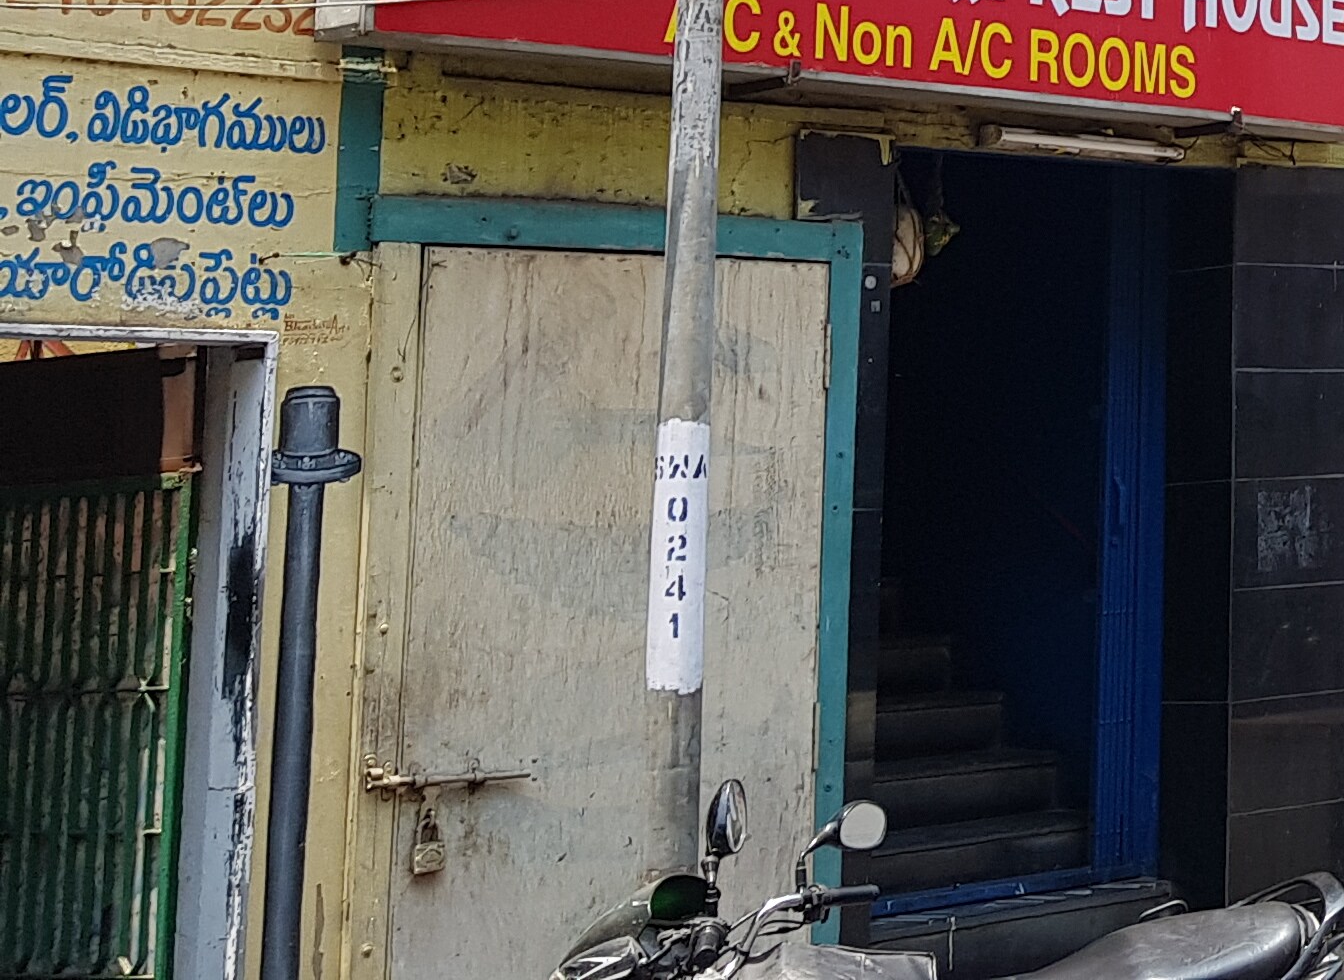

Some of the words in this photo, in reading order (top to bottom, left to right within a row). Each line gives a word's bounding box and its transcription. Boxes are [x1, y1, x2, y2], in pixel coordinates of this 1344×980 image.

[773, 9, 802, 58] &
[815, 2, 912, 69] Non
[929, 17, 1013, 78] A/C
[1030, 28, 1197, 100] ROOMS
